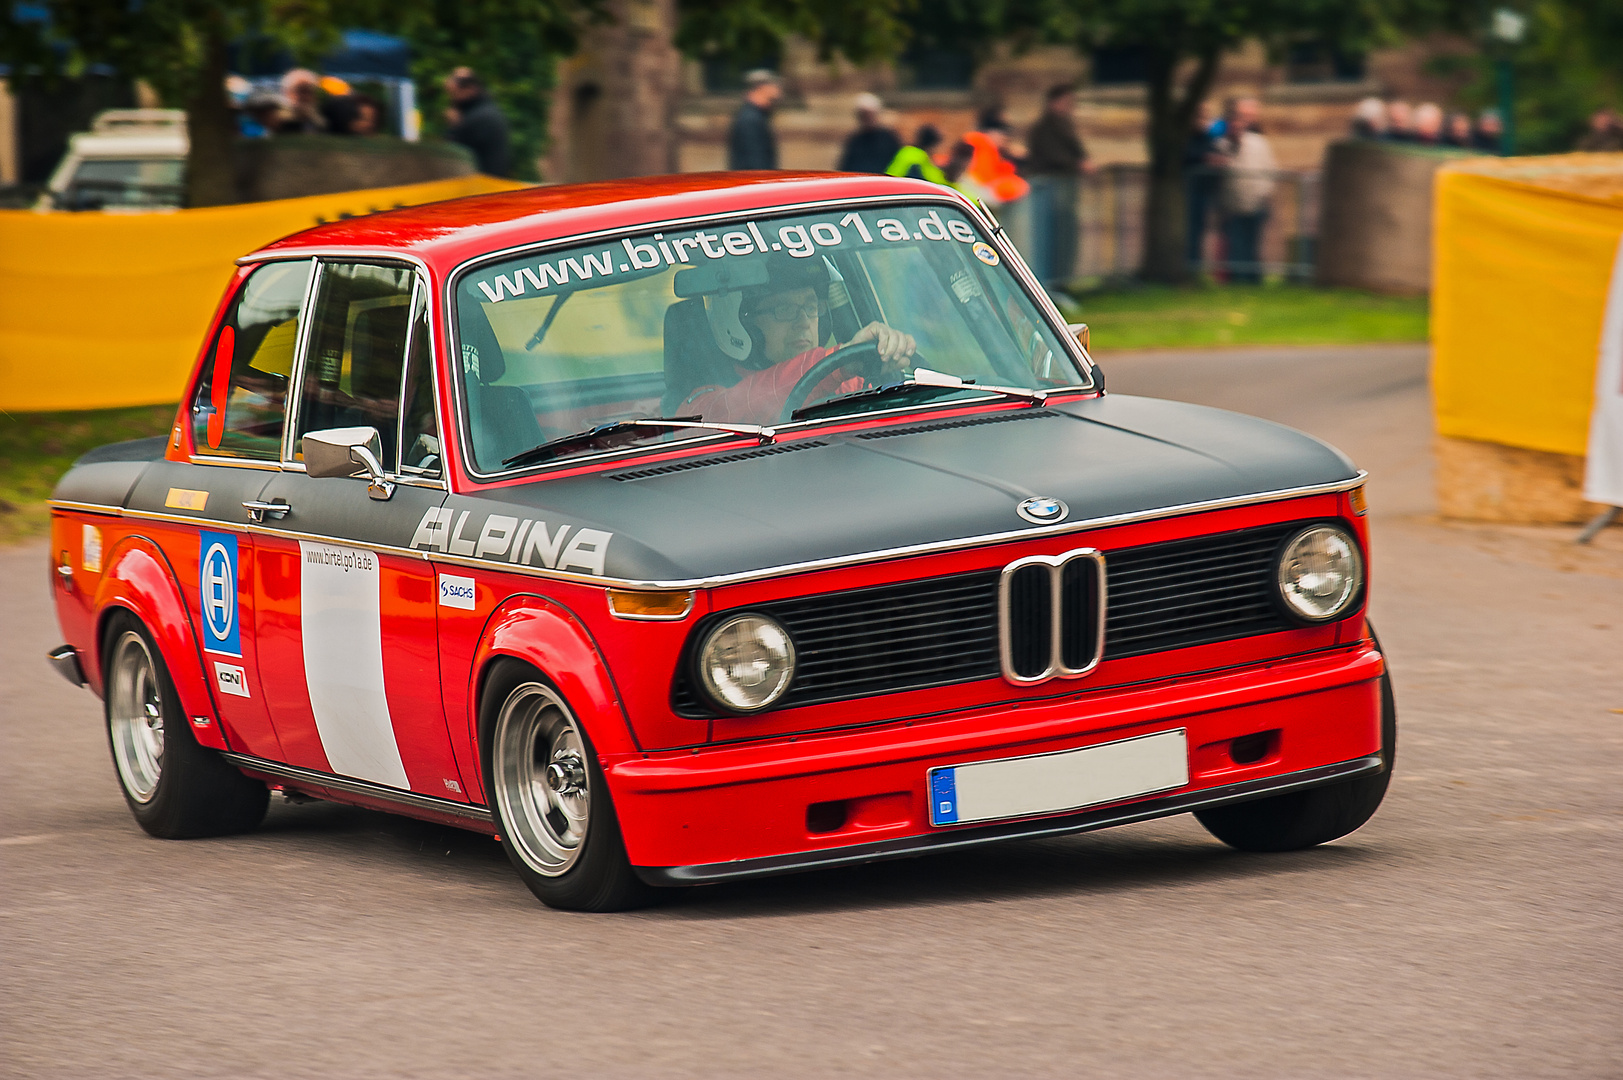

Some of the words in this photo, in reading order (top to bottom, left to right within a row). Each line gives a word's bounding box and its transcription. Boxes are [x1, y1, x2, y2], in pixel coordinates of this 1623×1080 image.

[409, 505, 614, 576] ALPINA
[305, 547, 373, 573] www.birtel.go1a.de
[449, 584, 474, 599] SACHS
[940, 801, 953, 814] D
